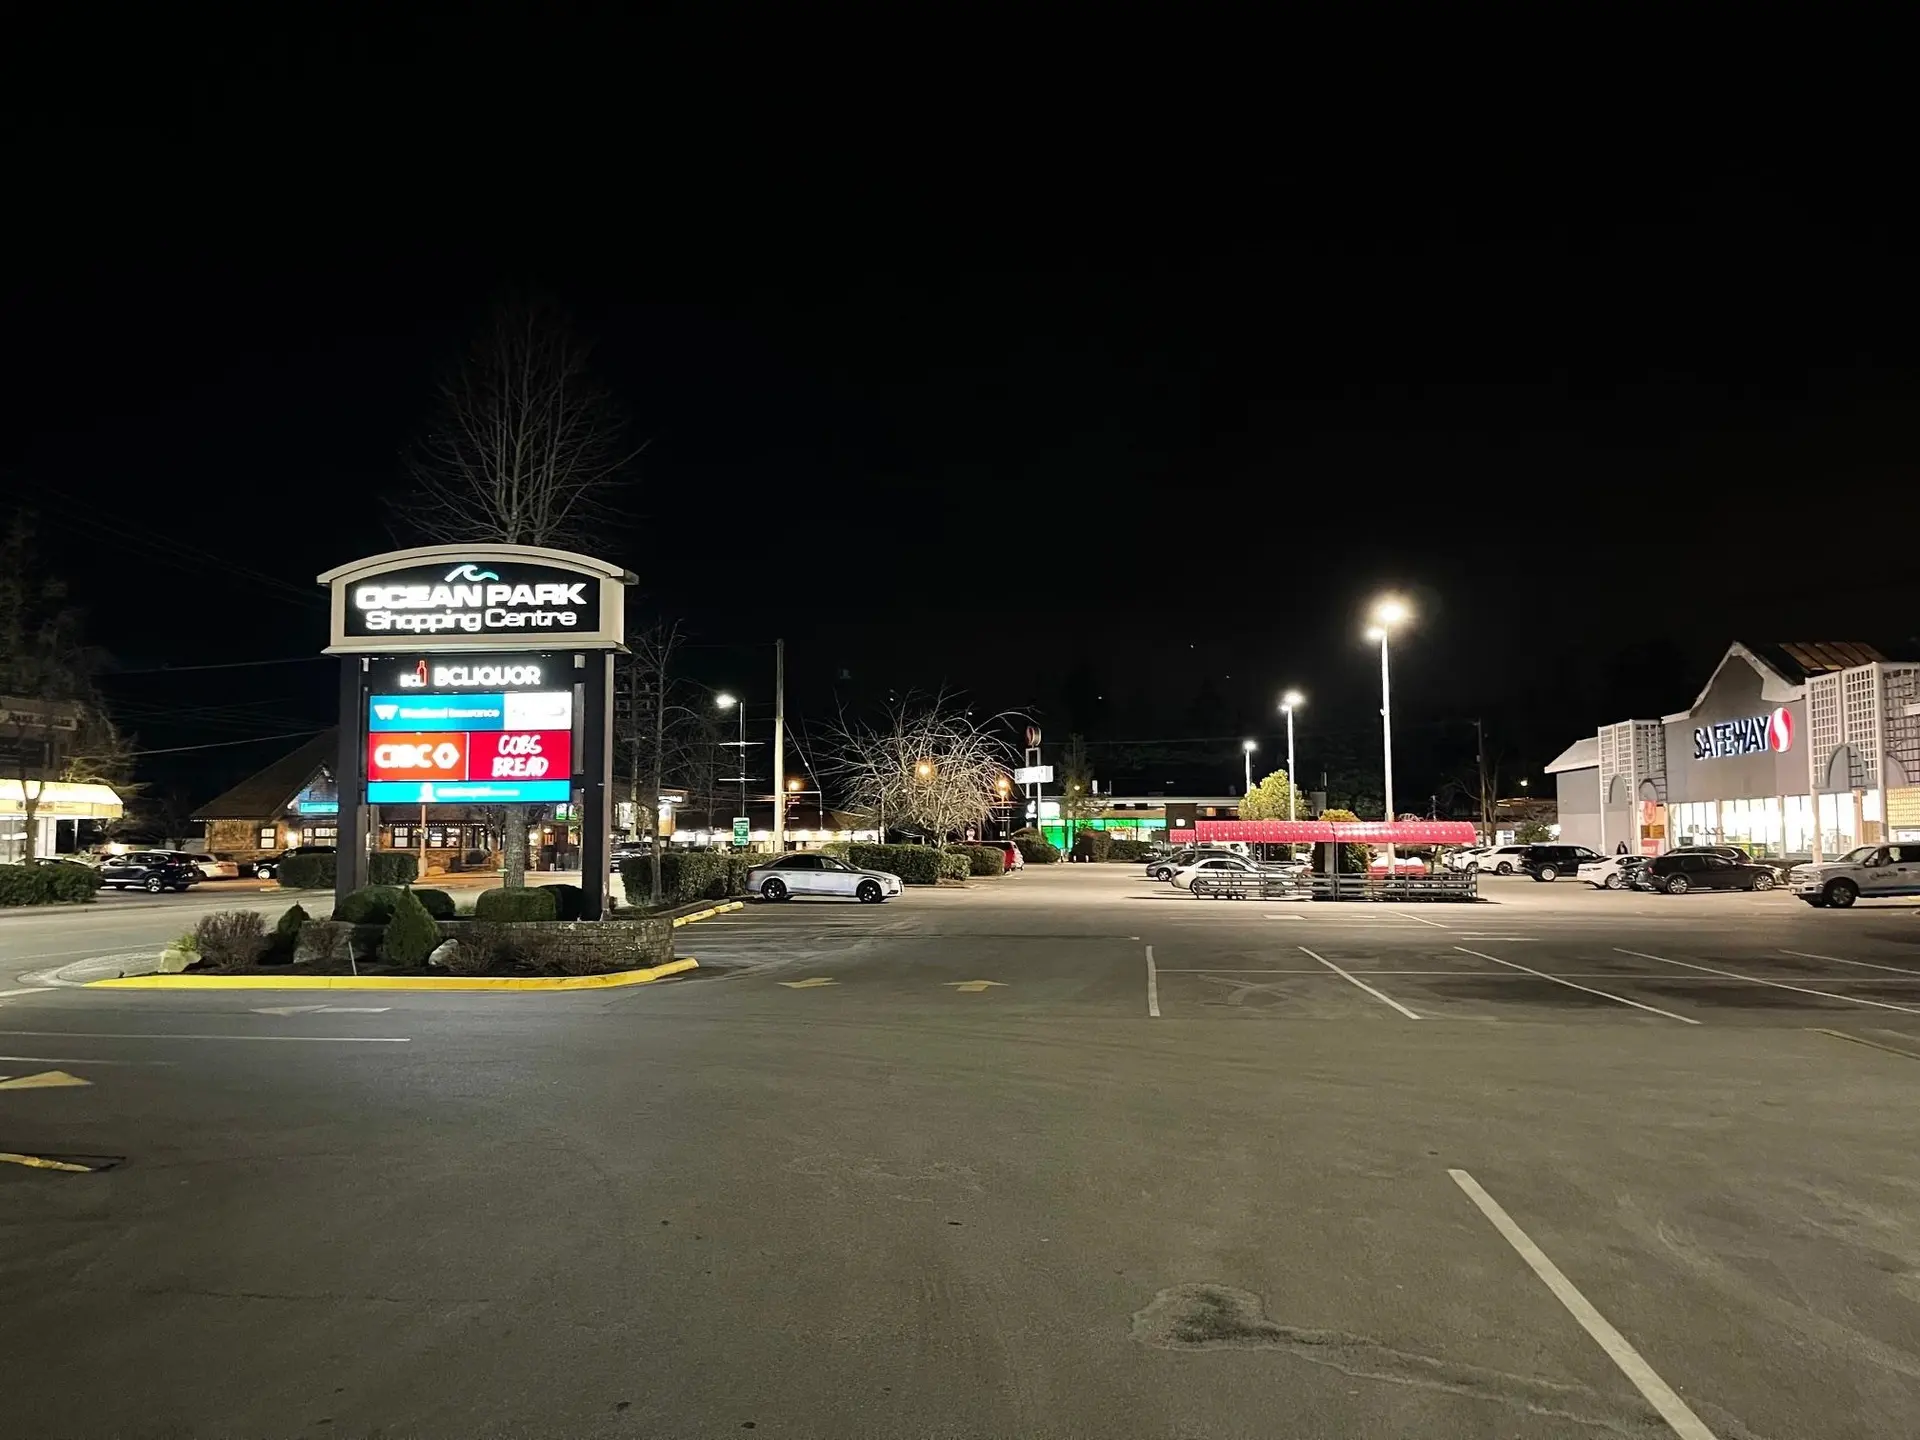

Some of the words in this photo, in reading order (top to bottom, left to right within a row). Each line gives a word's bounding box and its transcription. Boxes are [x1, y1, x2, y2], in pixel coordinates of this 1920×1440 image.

[356, 585, 482, 609] OCEAN
[487, 583, 587, 606] PARK
[366, 610, 482, 633] Shopping
[485, 609, 577, 628] Centre
[498, 735, 542, 755] COBS
[1694, 716, 1770, 760] SAFEWAY
[491, 757, 549, 777] BREAD
